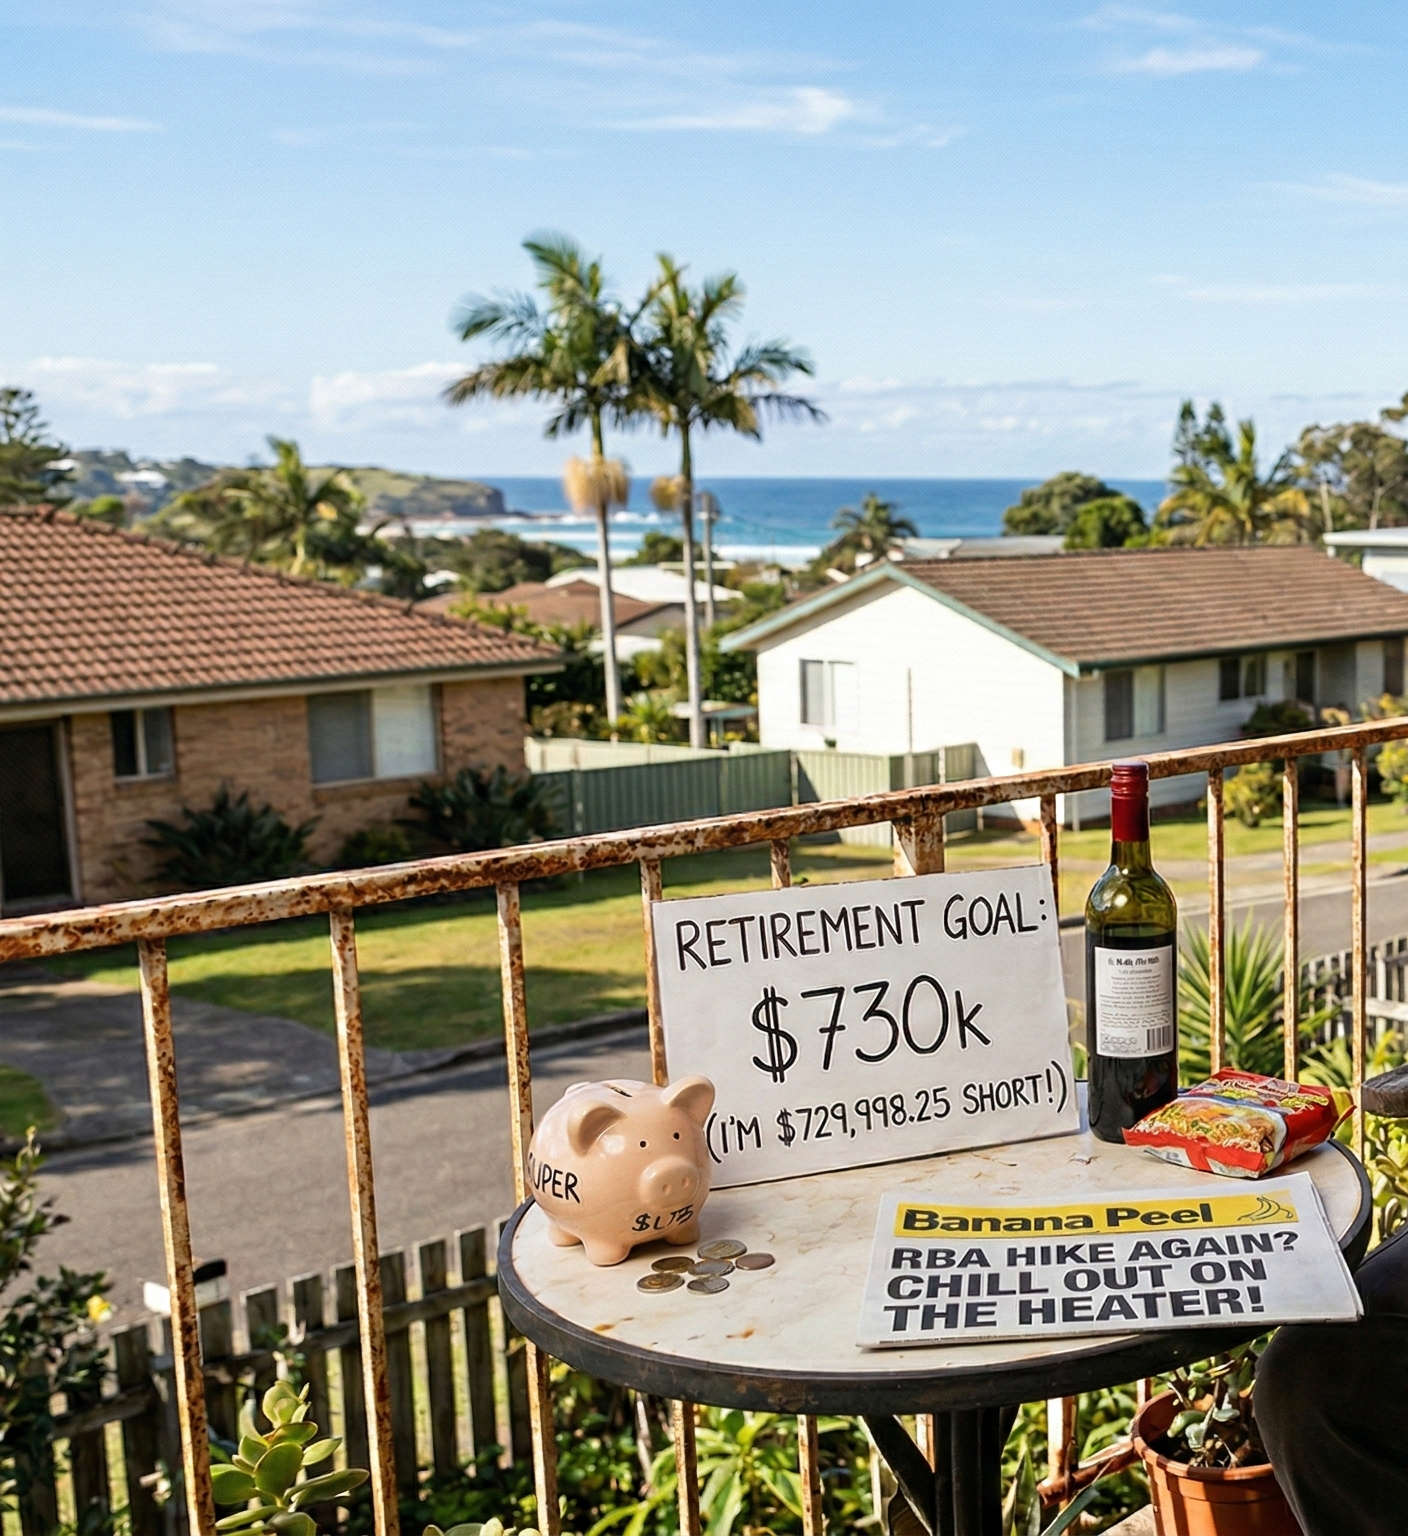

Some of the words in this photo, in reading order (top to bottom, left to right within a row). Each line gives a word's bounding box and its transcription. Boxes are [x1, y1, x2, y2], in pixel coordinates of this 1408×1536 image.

[674, 899, 926, 971] RETIREMENT
[943, 892, 1048, 941] GOAL:
[705, 1111, 762, 1164] (I'M
[776, 1086, 952, 1148] $729,998.25
[962, 1060, 1069, 1115] SHORT!)
[901, 1208, 1095, 1233] Banana
[1105, 1204, 1213, 1227] Peel
[890, 1246, 992, 1269] RBA
[1006, 1242, 1115, 1267] HIKE
[1127, 1230, 1299, 1262] AGAIN?
[886, 1271, 1050, 1300] CHILL
[1063, 1264, 1173, 1292] OUT
[1190, 1259, 1268, 1285] ON
[884, 1301, 998, 1332] THE
[1017, 1286, 1265, 1326] HEATER!
